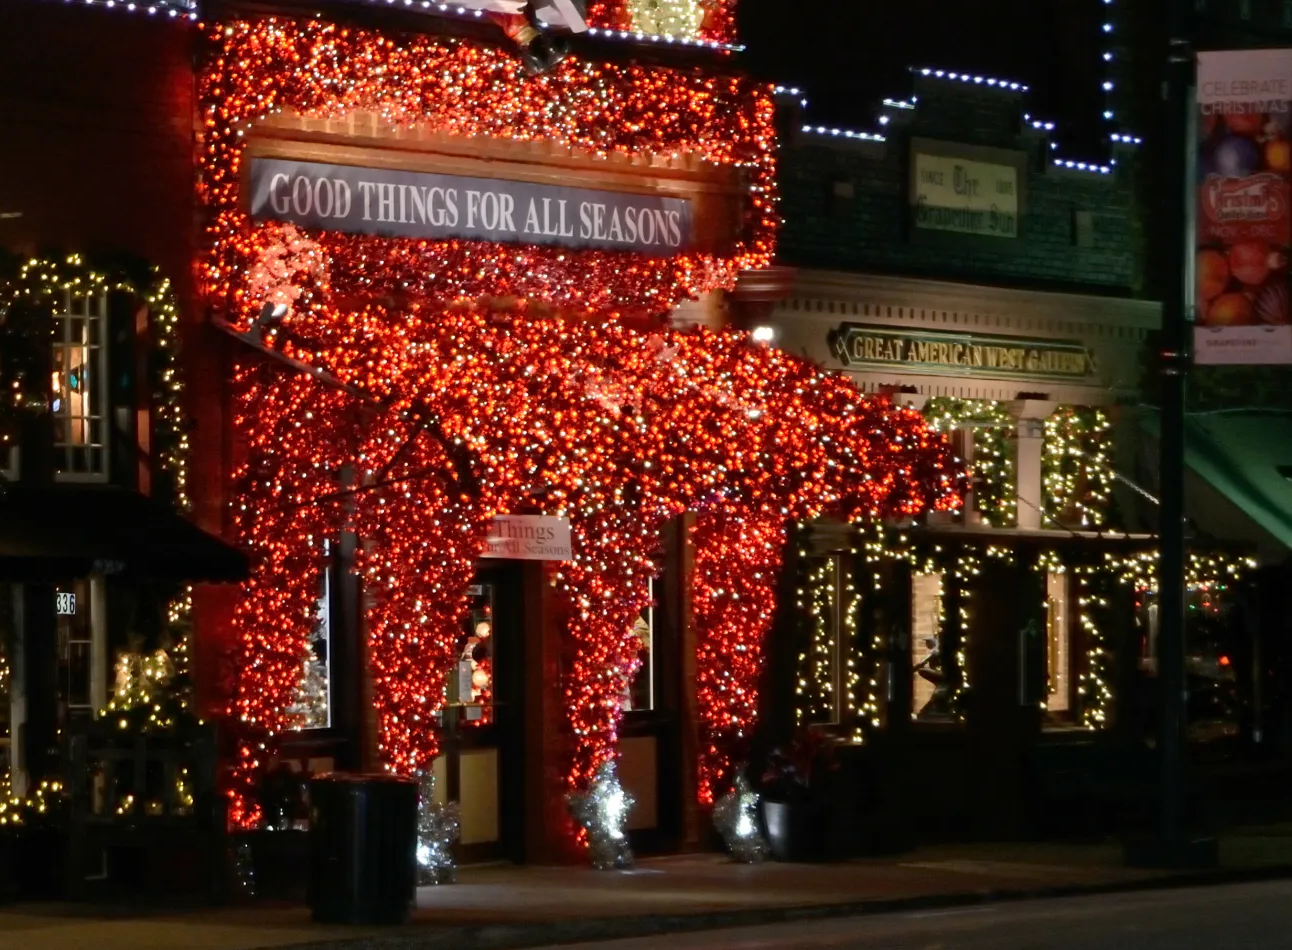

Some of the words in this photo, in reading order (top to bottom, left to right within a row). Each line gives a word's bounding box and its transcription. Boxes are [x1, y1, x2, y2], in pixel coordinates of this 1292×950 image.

[1202, 80, 1289, 97] CELEBRATE
[1200, 100, 1289, 116] CHRISTMAS
[920, 168, 944, 187] SINCE
[270, 172, 351, 219] GOOD
[359, 181, 459, 228] THINGS
[465, 190, 516, 232] FOR
[523, 197, 574, 238] ALL
[579, 201, 682, 247] SEASONS
[853, 336, 904, 361] GREAT
[907, 341, 983, 366] AMERICAN
[985, 346, 1026, 370] WEST
[496, 519, 555, 544] Things
[525, 543, 570, 556] Seasons
[56, 593, 76, 614] 336
